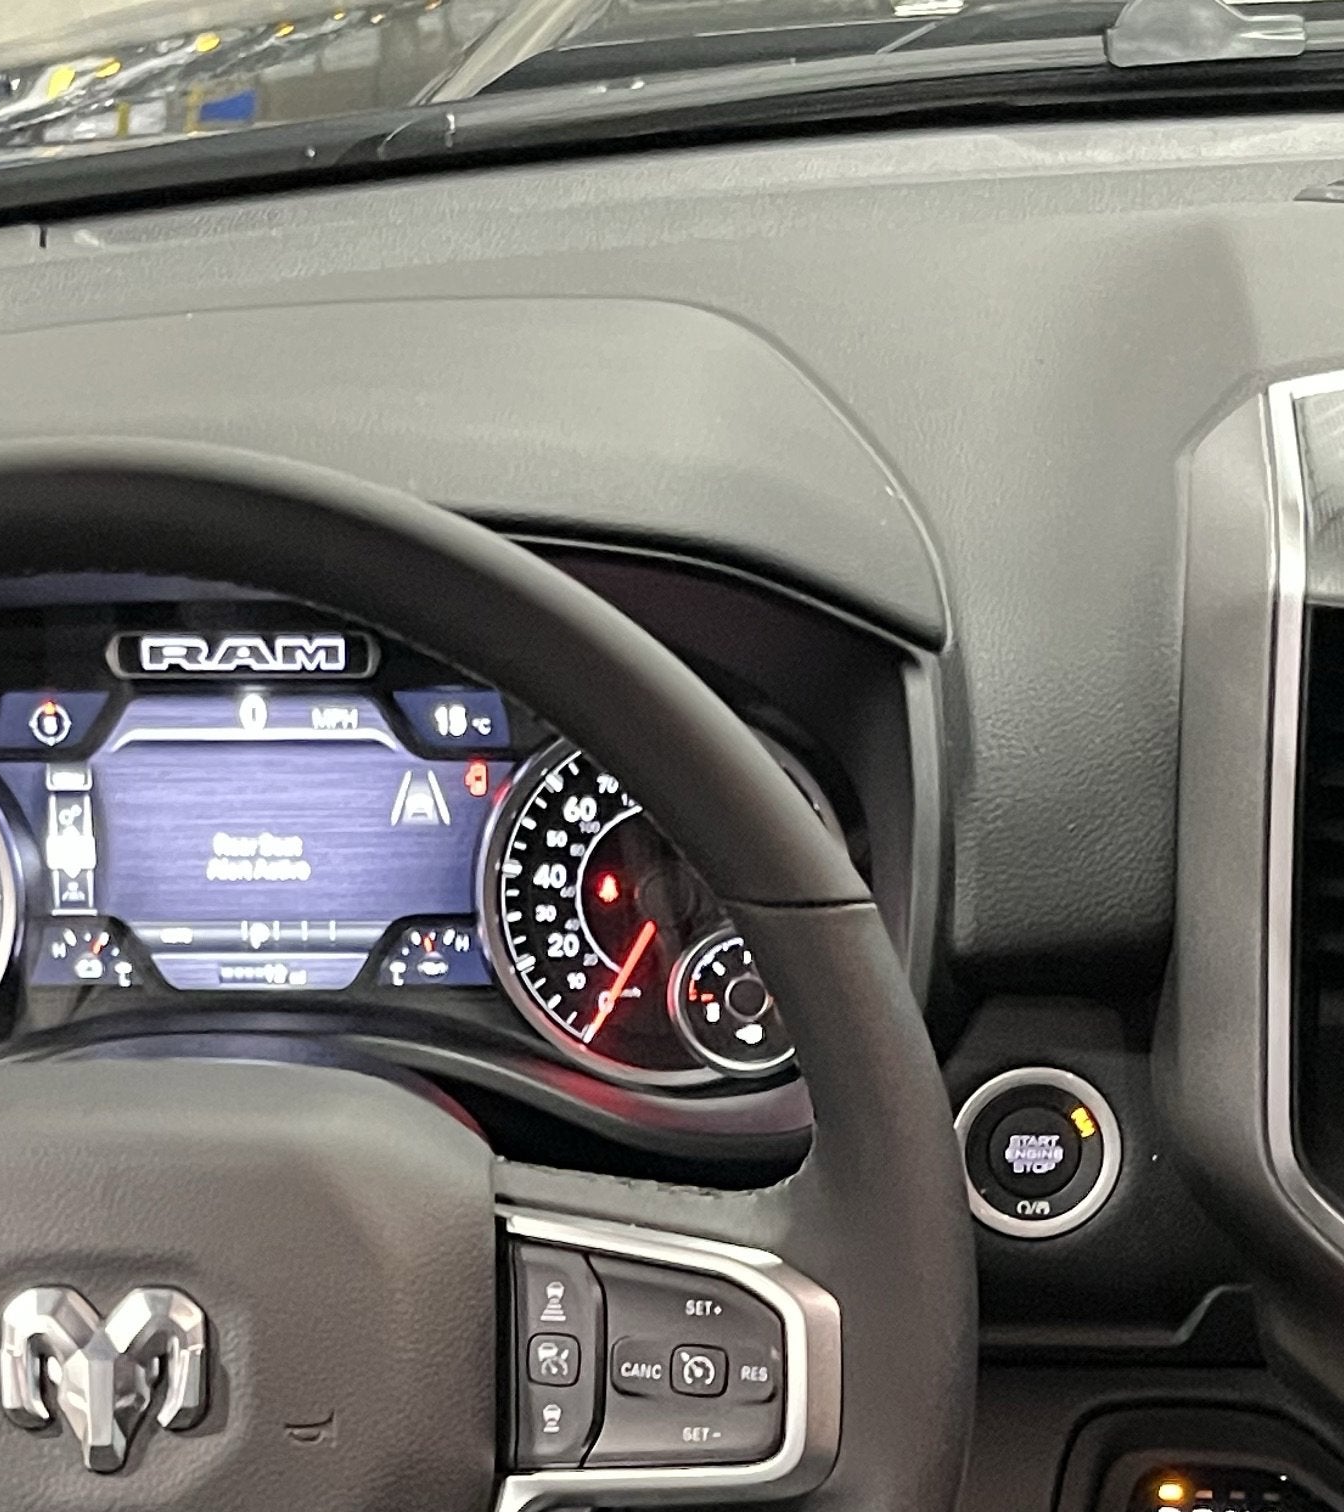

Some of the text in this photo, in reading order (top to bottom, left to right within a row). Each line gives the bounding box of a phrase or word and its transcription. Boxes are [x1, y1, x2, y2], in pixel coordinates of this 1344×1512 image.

[141, 636, 346, 671] RAM
[596, 774, 619, 794] 70
[563, 796, 597, 823] 60
[533, 864, 568, 889] 40
[547, 932, 580, 957] 20
[1009, 1134, 1060, 1148] START
[1013, 1161, 1056, 1174] STOP
[620, 1362, 662, 1380] CANC
[740, 1365, 768, 1382] RES
